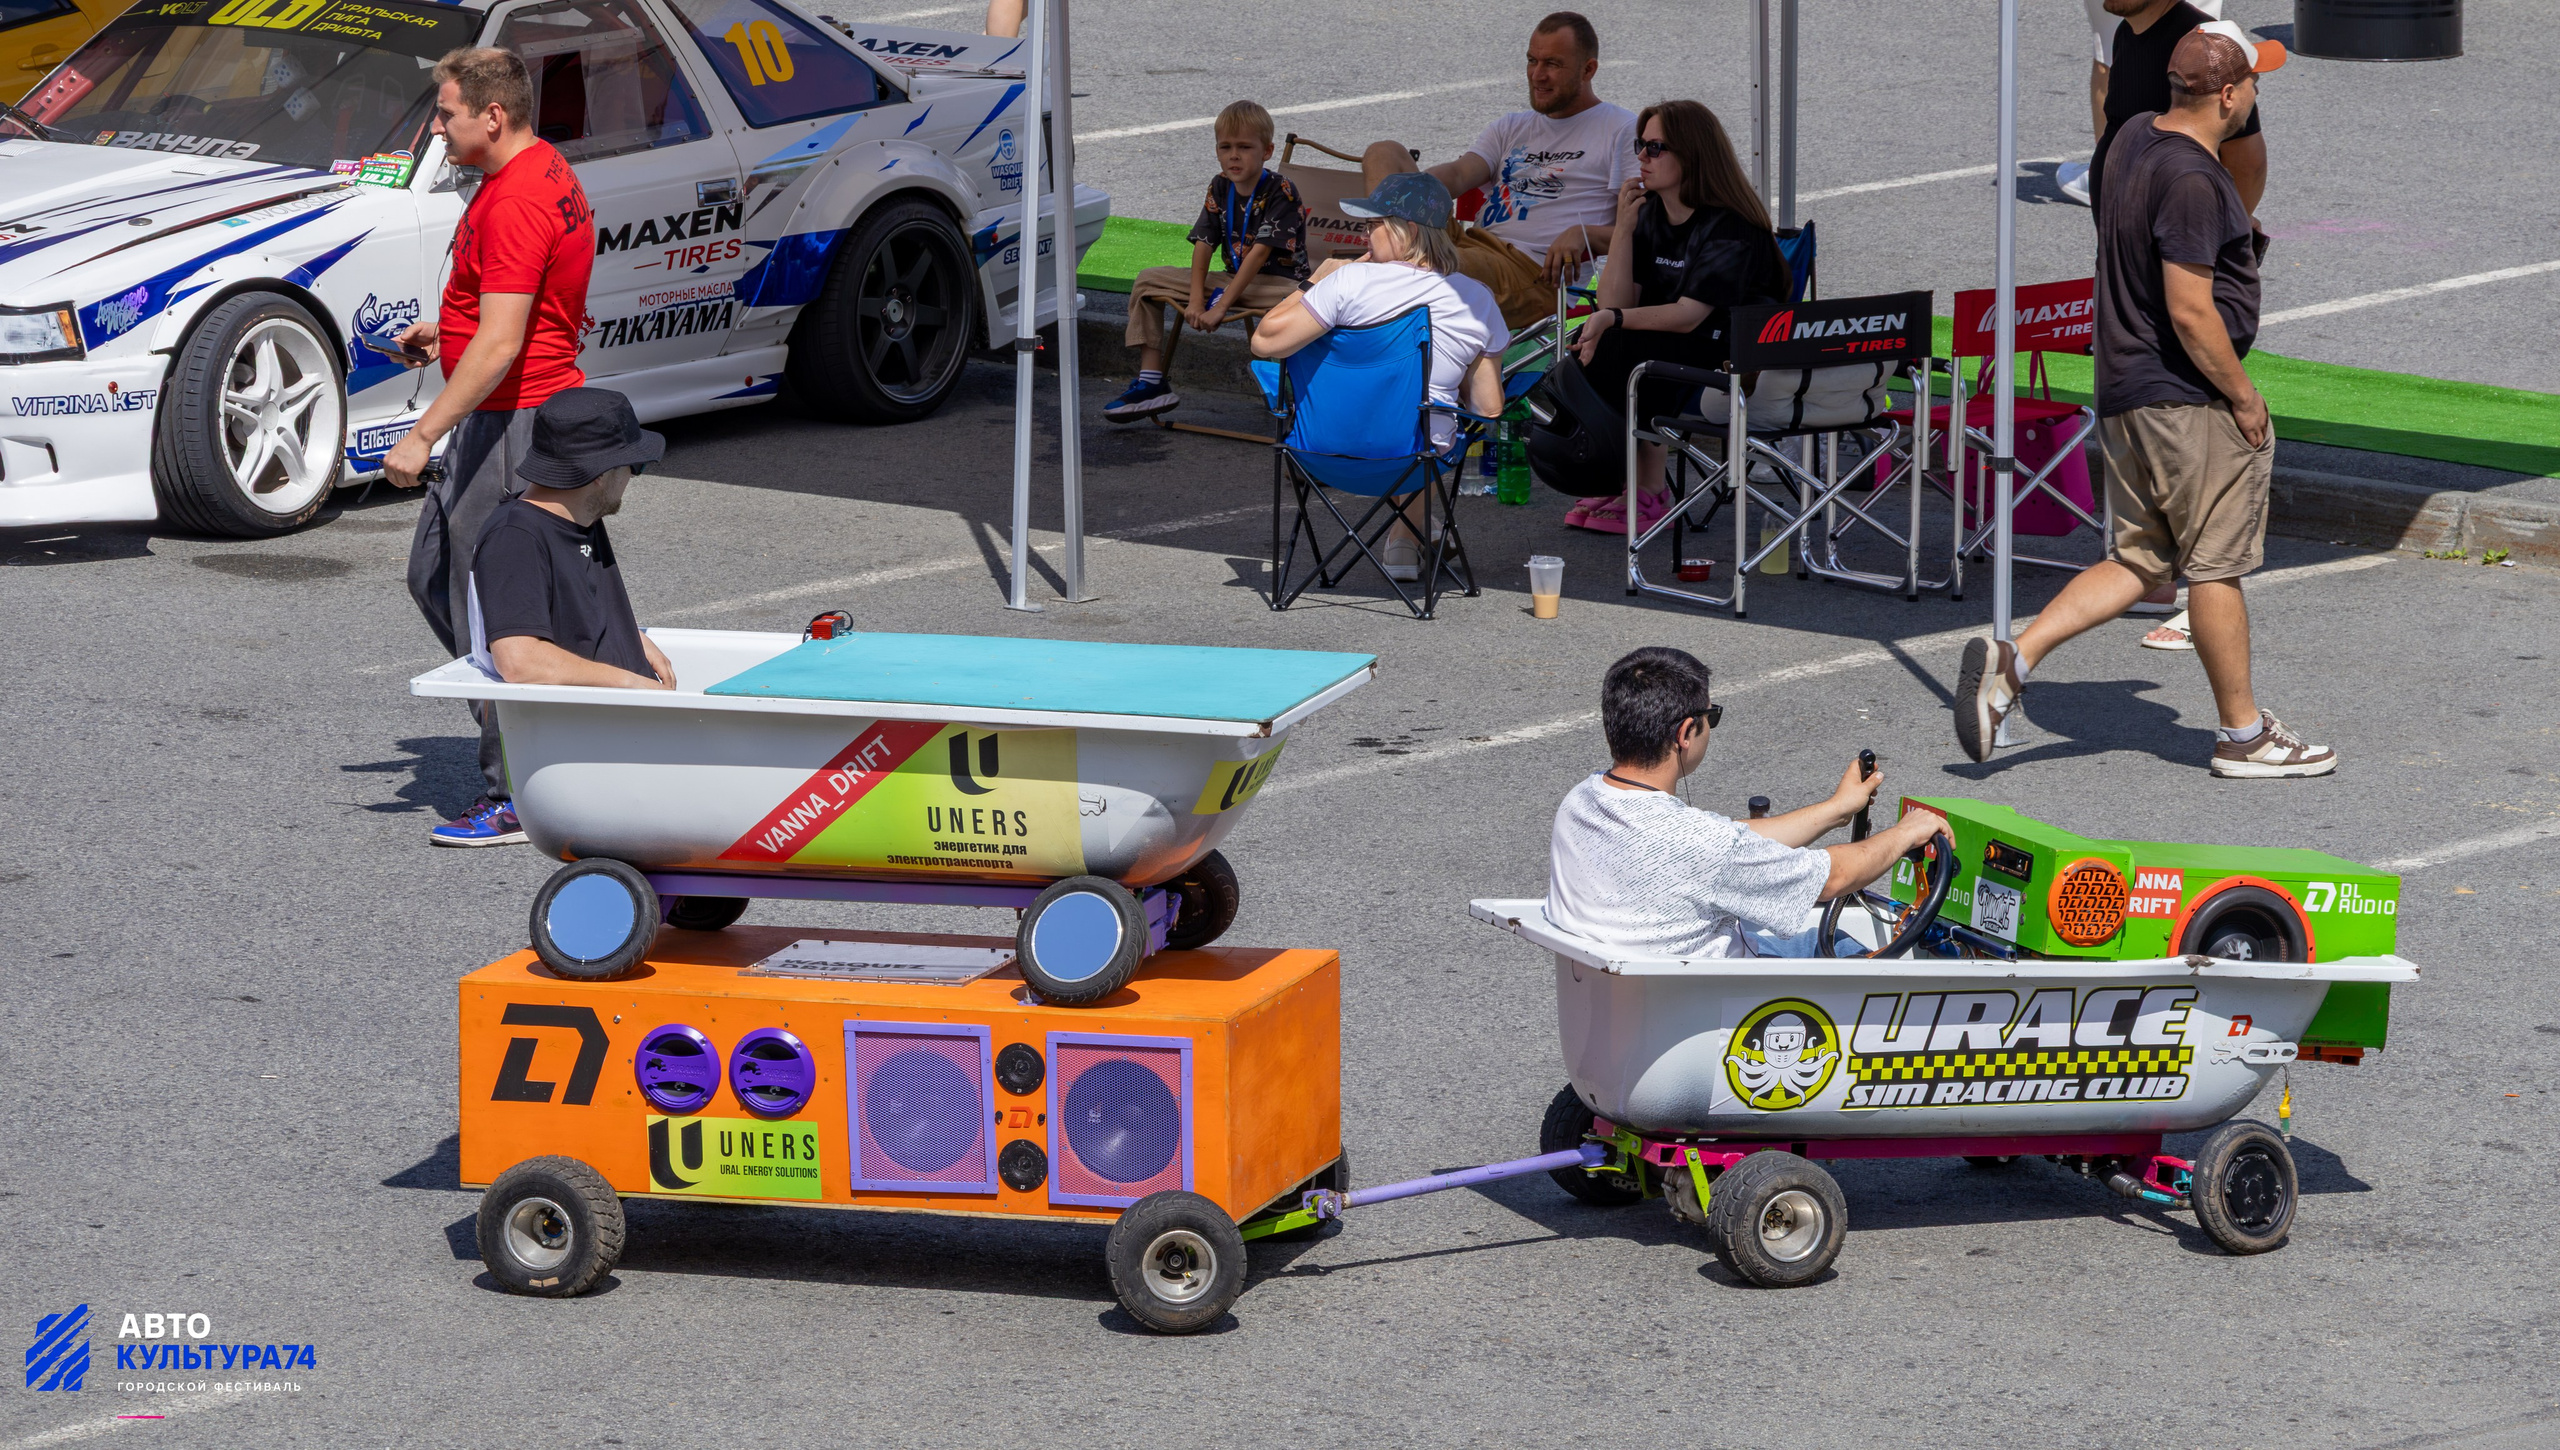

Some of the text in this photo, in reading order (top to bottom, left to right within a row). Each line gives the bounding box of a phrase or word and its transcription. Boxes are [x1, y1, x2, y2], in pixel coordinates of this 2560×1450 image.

[325, 12, 369, 25] ЛИГА
[339, 3, 438, 28] УРАЛЬСКАЯ
[311, 22, 383, 40] ДРИФТА
[724, 20, 795, 86] 10
[858, 38, 969, 58] AXEN
[877, 55, 950, 66] IRES
[107, 131, 261, 160] ВАЧУПЭ
[360, 172, 395, 184] ULD
[596, 203, 744, 255] MAXEN
[664, 238, 742, 270] TIRES
[639, 281, 734, 307] МОТОРНЫЕ МАСЛА
[379, 298, 419, 321] Print
[598, 301, 734, 348] TAKAYAMA
[1792, 313, 1907, 340] MAXEN
[2052, 322, 2092, 339] TIRE
[1846, 337, 1906, 353] TIRES
[12, 390, 157, 417] VITRINA KST
[756, 734, 892, 855] VANNA_DRIFT
[927, 806, 1028, 837] UNERS
[934, 841, 1027, 856] энергетик для
[887, 854, 1013, 869] электротранспорта
[2340, 883, 2362, 898] DL
[2129, 897, 2176, 914] RIFT
[2339, 899, 2395, 915] AUDIO
[778, 963, 863, 972] DRIFT
[784, 959, 926, 970] WASQUEZ
[1853, 986, 2199, 1054] URACE
[1941, 1077, 2081, 1104] RACING
[2084, 1075, 2188, 1100] CLUB
[720, 1131, 815, 1161] UNERS
[720, 1164, 818, 1179] URAL ENERGY SOLUTIONS
